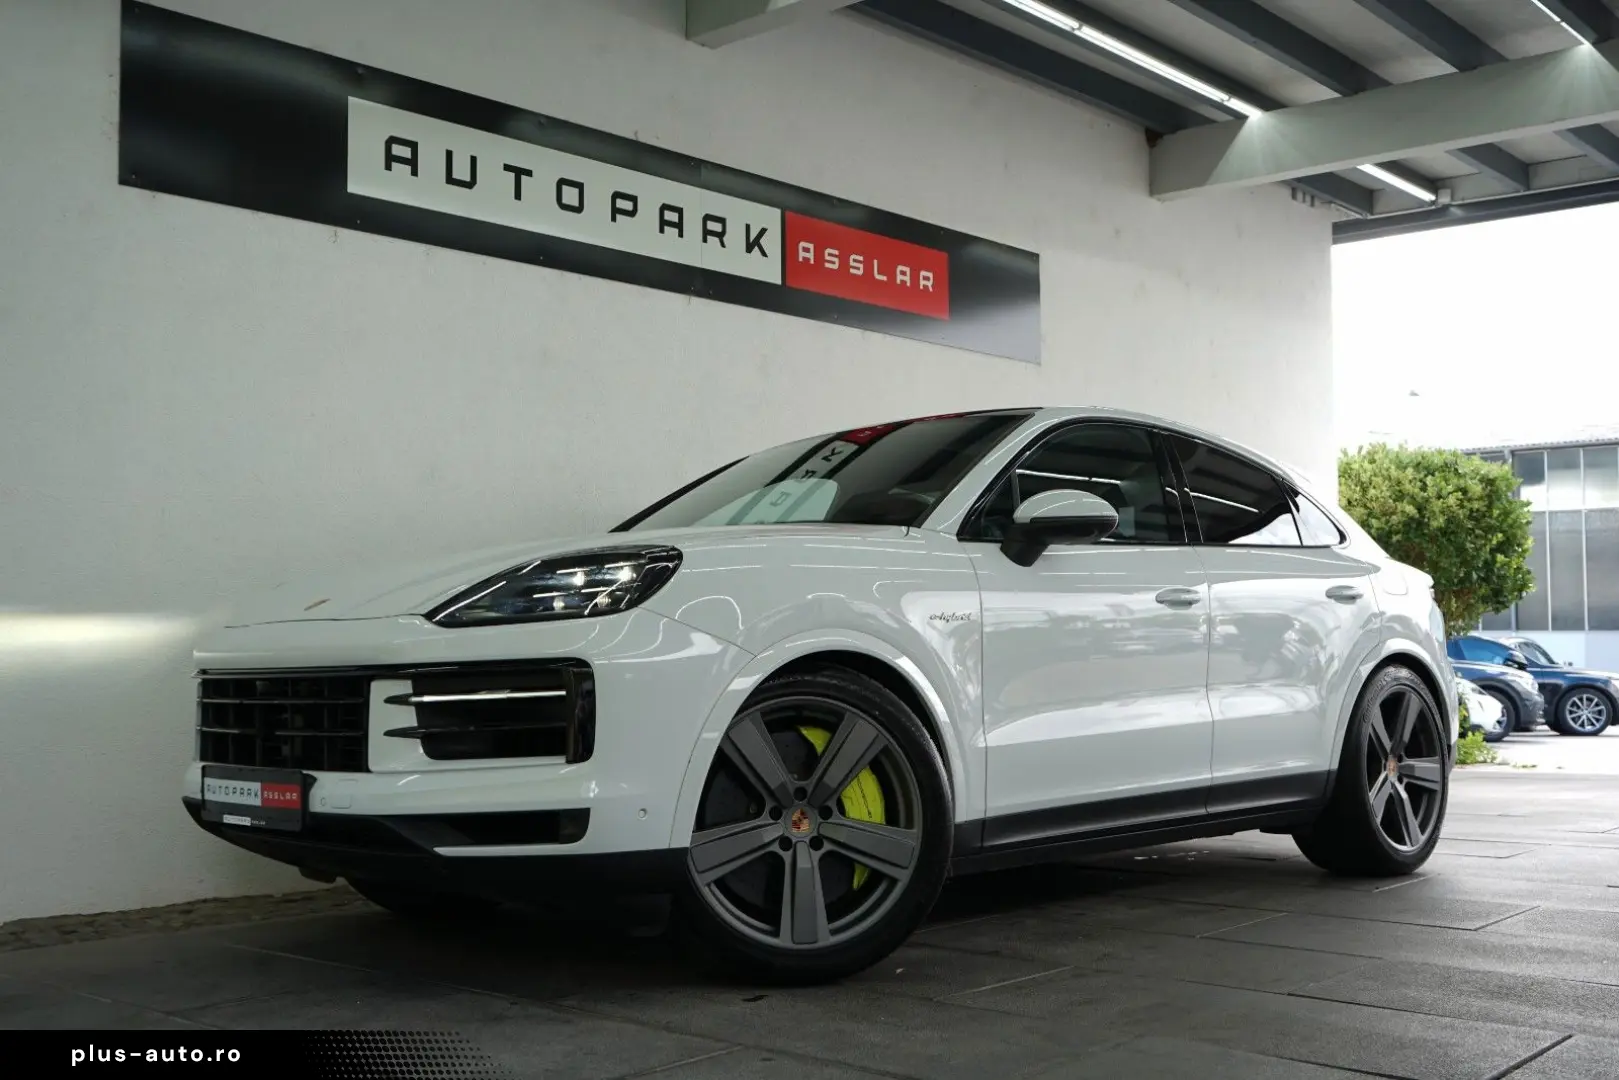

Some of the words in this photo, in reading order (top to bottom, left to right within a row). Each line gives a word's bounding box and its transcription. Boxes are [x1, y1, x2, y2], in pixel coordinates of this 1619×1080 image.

[383, 134, 770, 259] AUTOPARK
[797, 240, 935, 293] ASSLAR
[206, 783, 259, 799] AUTOPARK
[263, 790, 298, 800] ASSLAR
